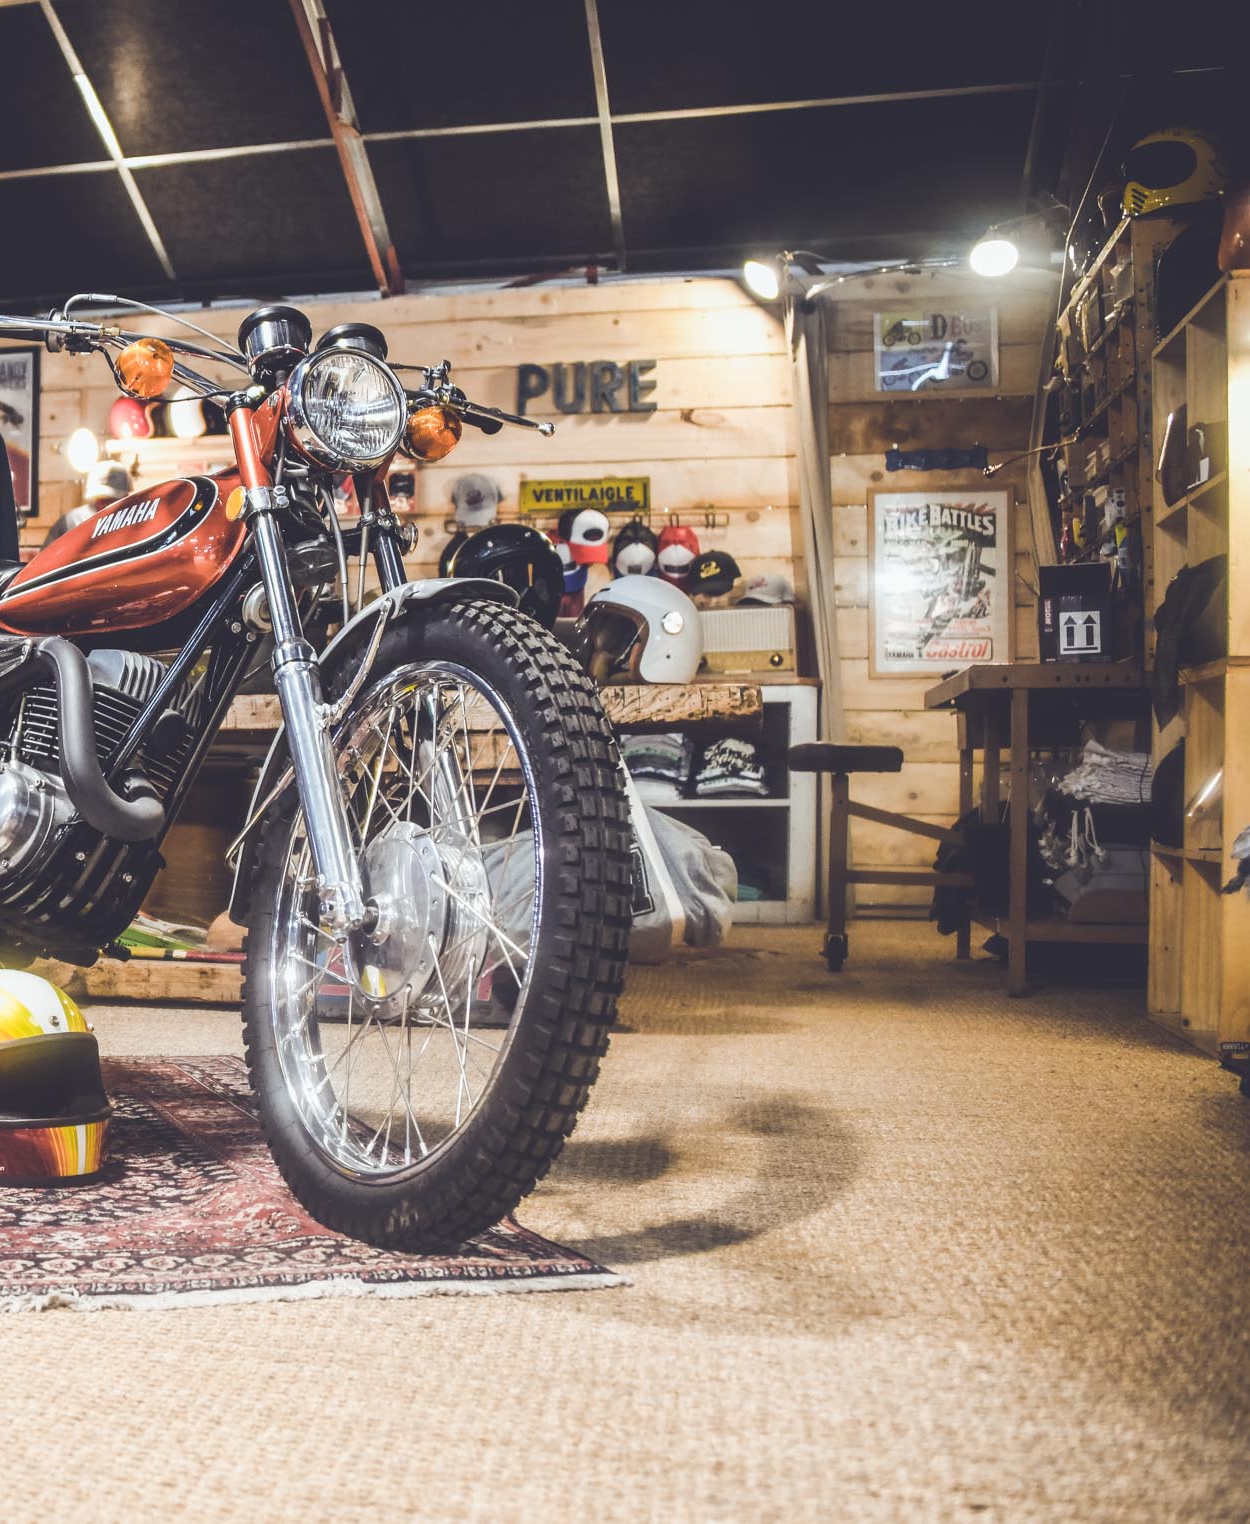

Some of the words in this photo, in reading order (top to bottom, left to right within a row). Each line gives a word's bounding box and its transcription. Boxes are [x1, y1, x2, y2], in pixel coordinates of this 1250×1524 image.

[517, 360, 658, 416] PURE
[532, 486, 635, 503] VENTILAIGLE
[91, 497, 161, 539] YAMAHA
[929, 504, 995, 536] BATTLES
